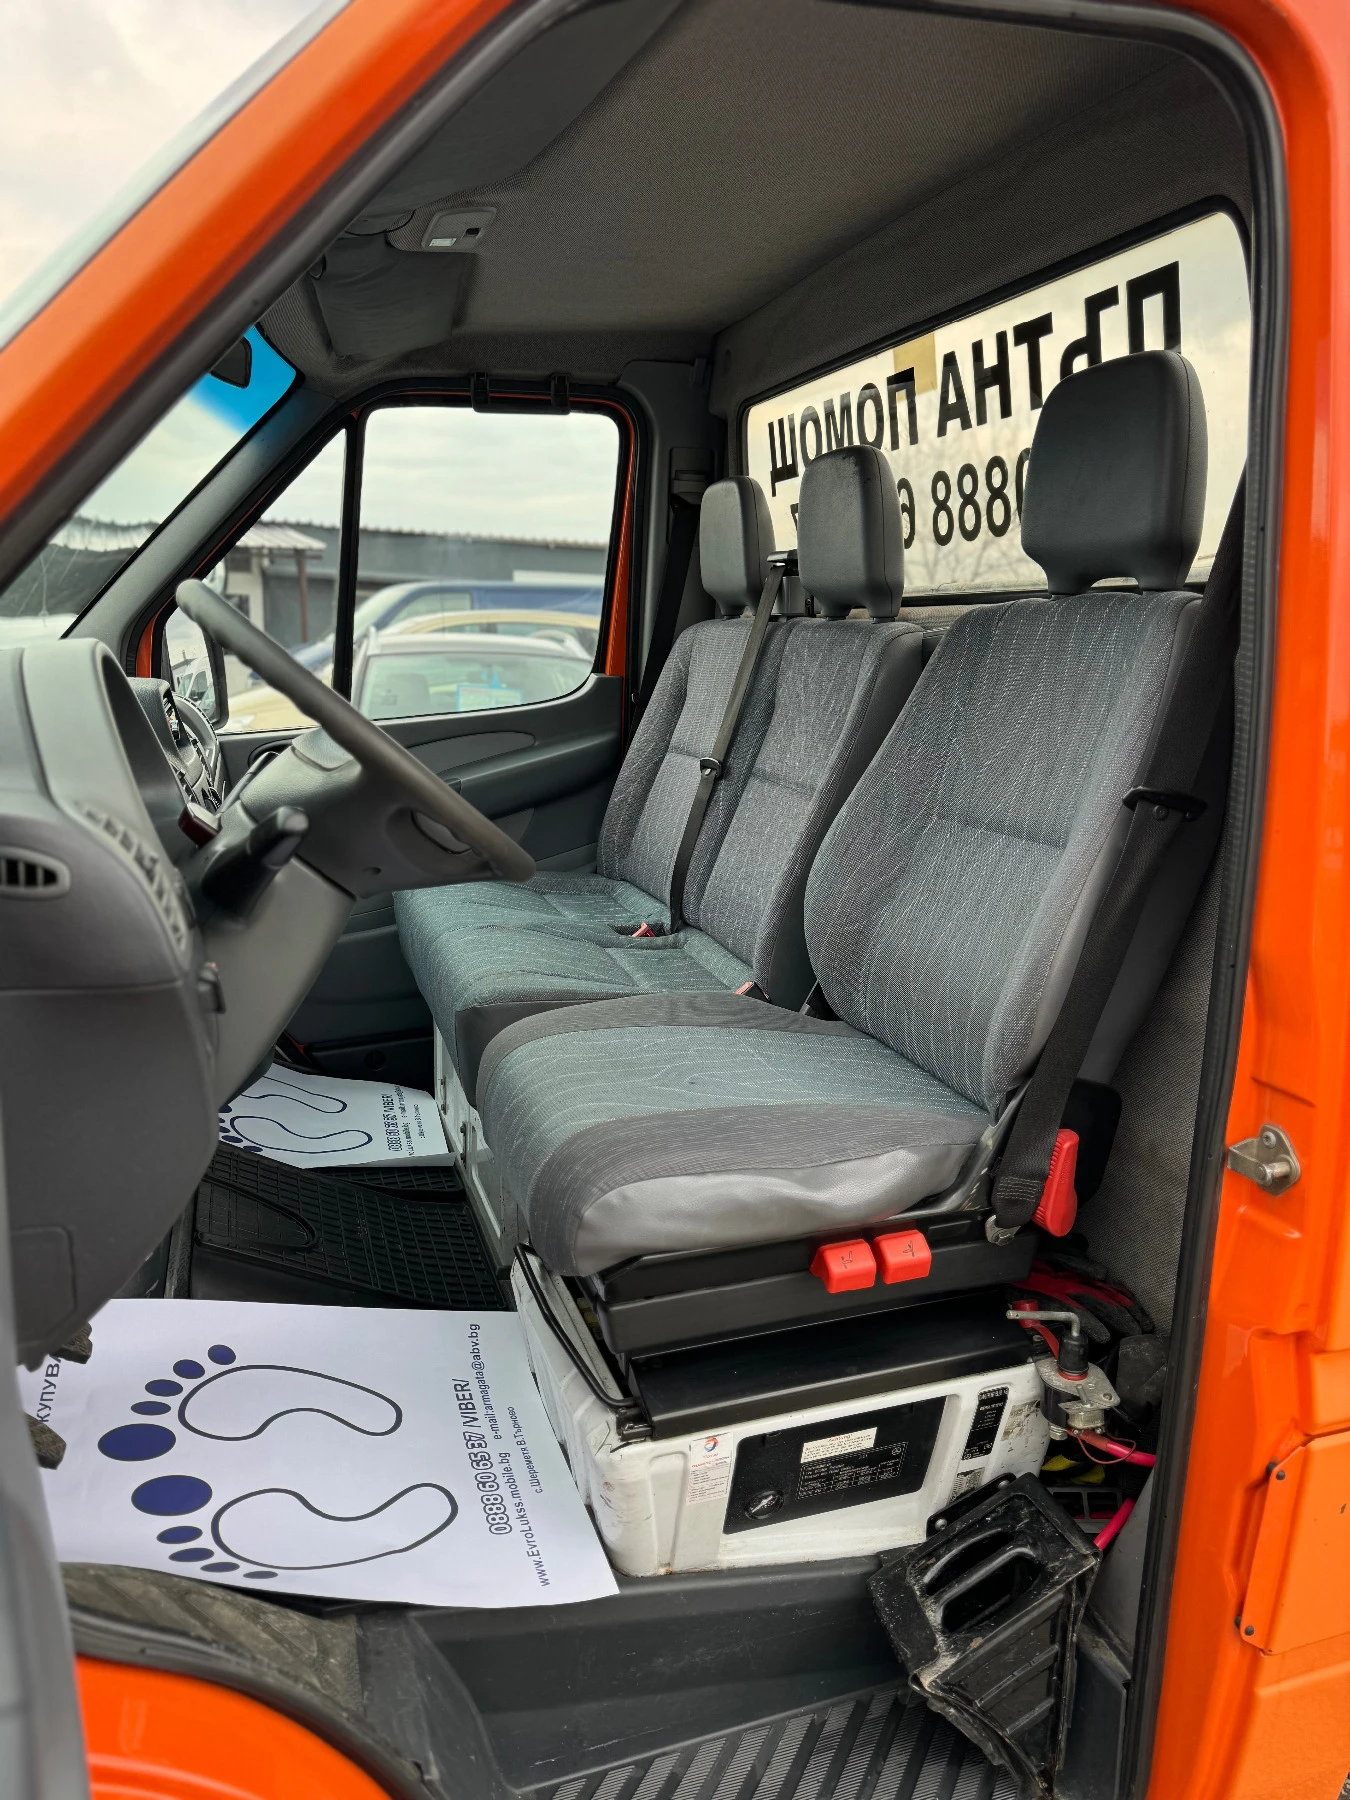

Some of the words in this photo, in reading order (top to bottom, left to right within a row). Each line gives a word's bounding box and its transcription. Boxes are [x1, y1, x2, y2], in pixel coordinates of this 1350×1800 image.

[469, 1323, 503, 1440] e-mail:armagata@abv.bg
[452, 1378, 482, 1427] /VIBER/
[463, 1431, 486, 1449] 37
[470, 1451, 493, 1470] 65
[475, 1472, 499, 1492] 60
[481, 1494, 512, 1535] 0888
[497, 1452, 551, 1587] www.EvroLukss.mobile.bg
